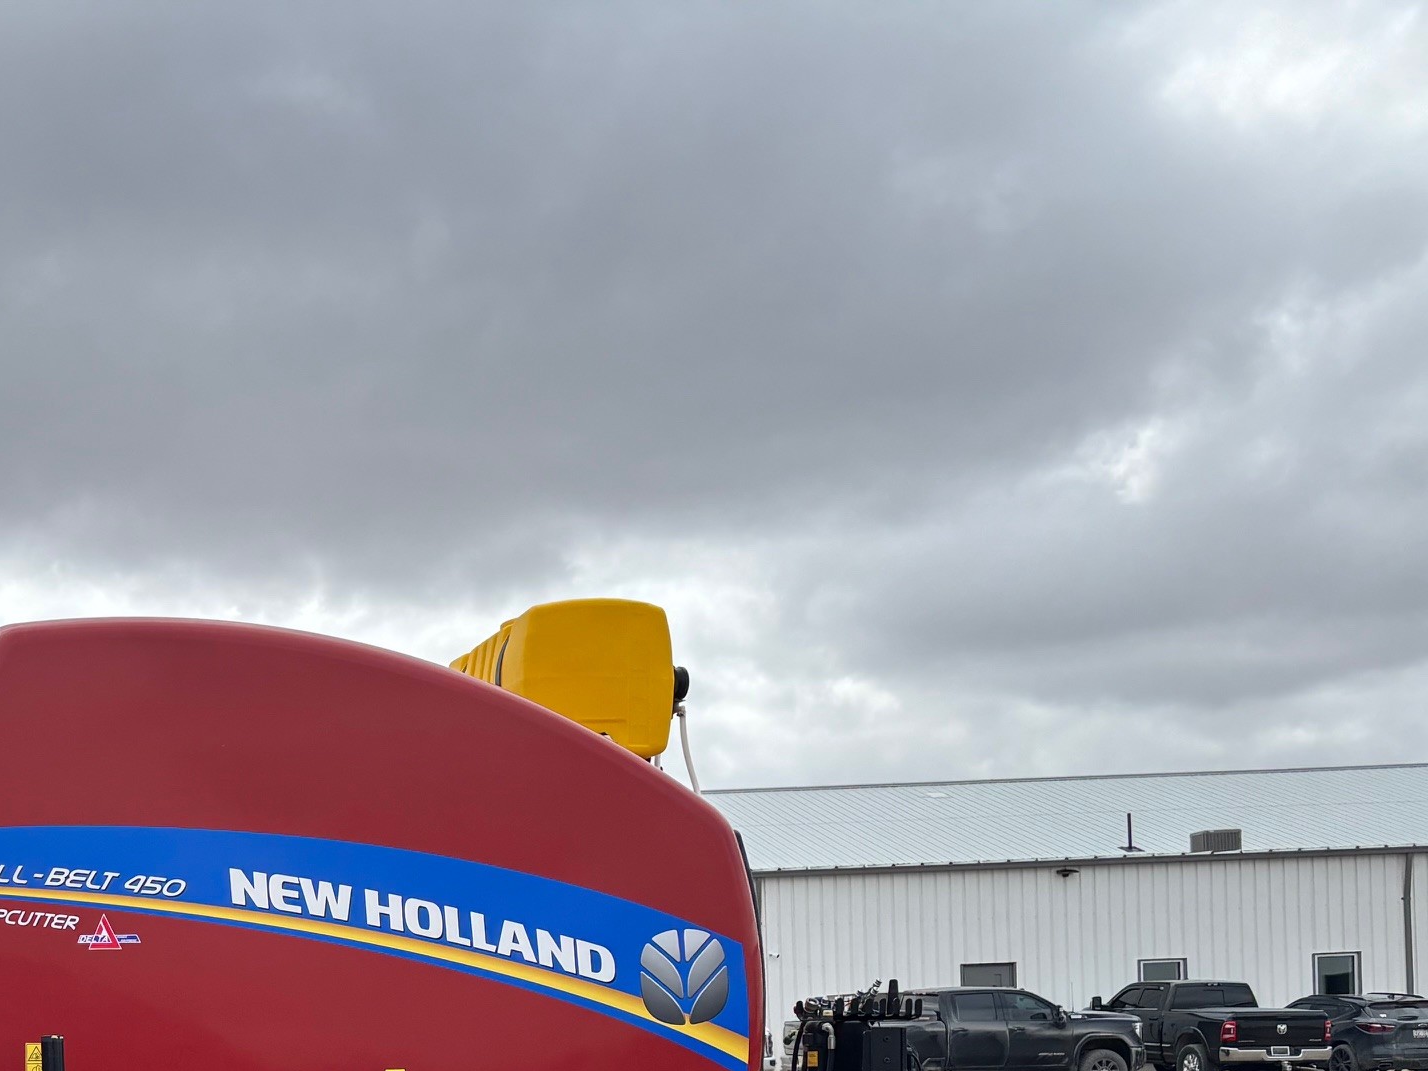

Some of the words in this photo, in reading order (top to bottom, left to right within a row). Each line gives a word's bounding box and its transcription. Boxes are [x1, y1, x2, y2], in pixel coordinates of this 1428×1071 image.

[124, 875, 187, 897] 450
[228, 867, 353, 922] NEW
[364, 888, 617, 983] HOLLAND
